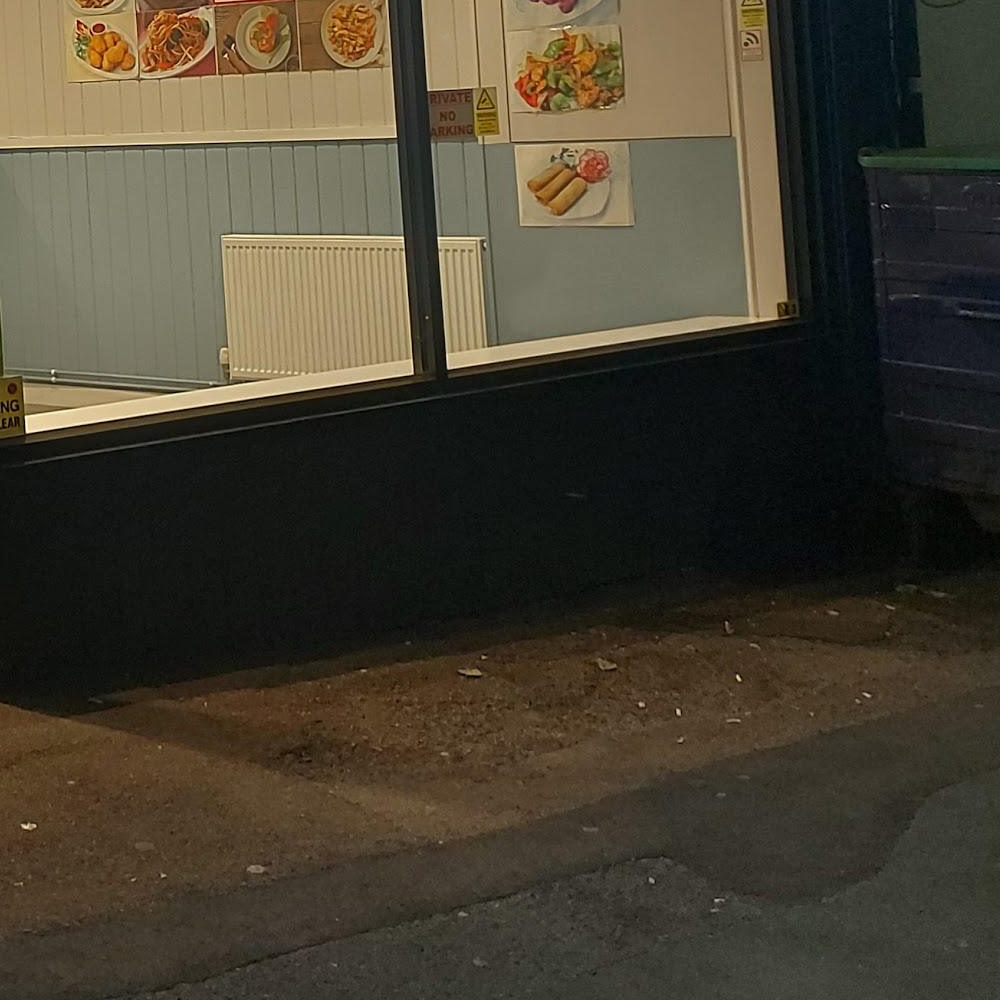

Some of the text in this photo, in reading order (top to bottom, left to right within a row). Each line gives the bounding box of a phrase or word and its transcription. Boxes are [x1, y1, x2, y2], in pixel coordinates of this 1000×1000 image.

[430, 92, 471, 105] RIVATE
[439, 111, 456, 122] NO
[431, 125, 474, 137] ARKING
